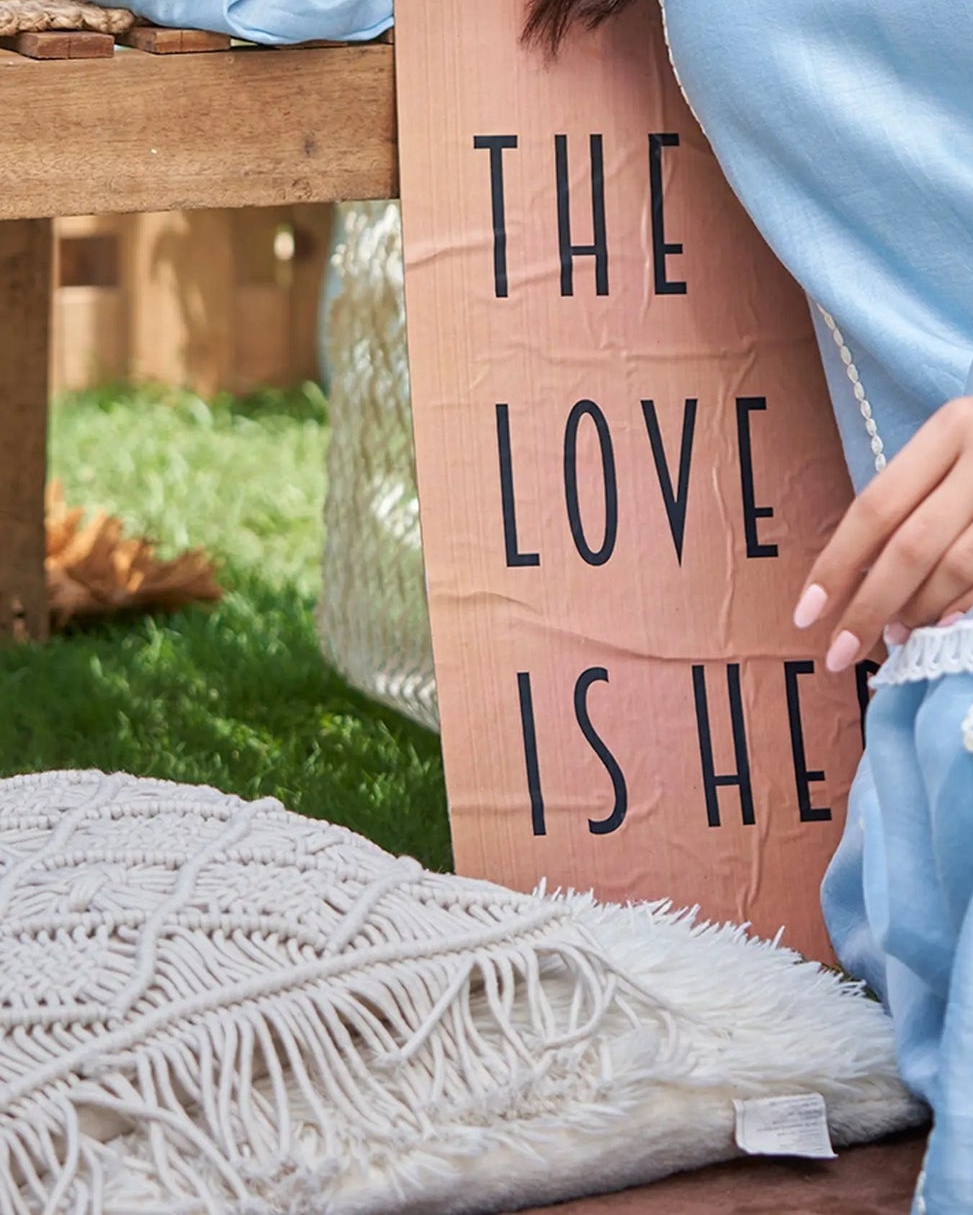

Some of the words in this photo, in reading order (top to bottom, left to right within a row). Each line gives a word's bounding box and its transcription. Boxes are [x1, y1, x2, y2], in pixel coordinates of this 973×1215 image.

[473, 133, 687, 298] THE
[495, 396, 779, 567] LOVE
[516, 666, 628, 836] IS
